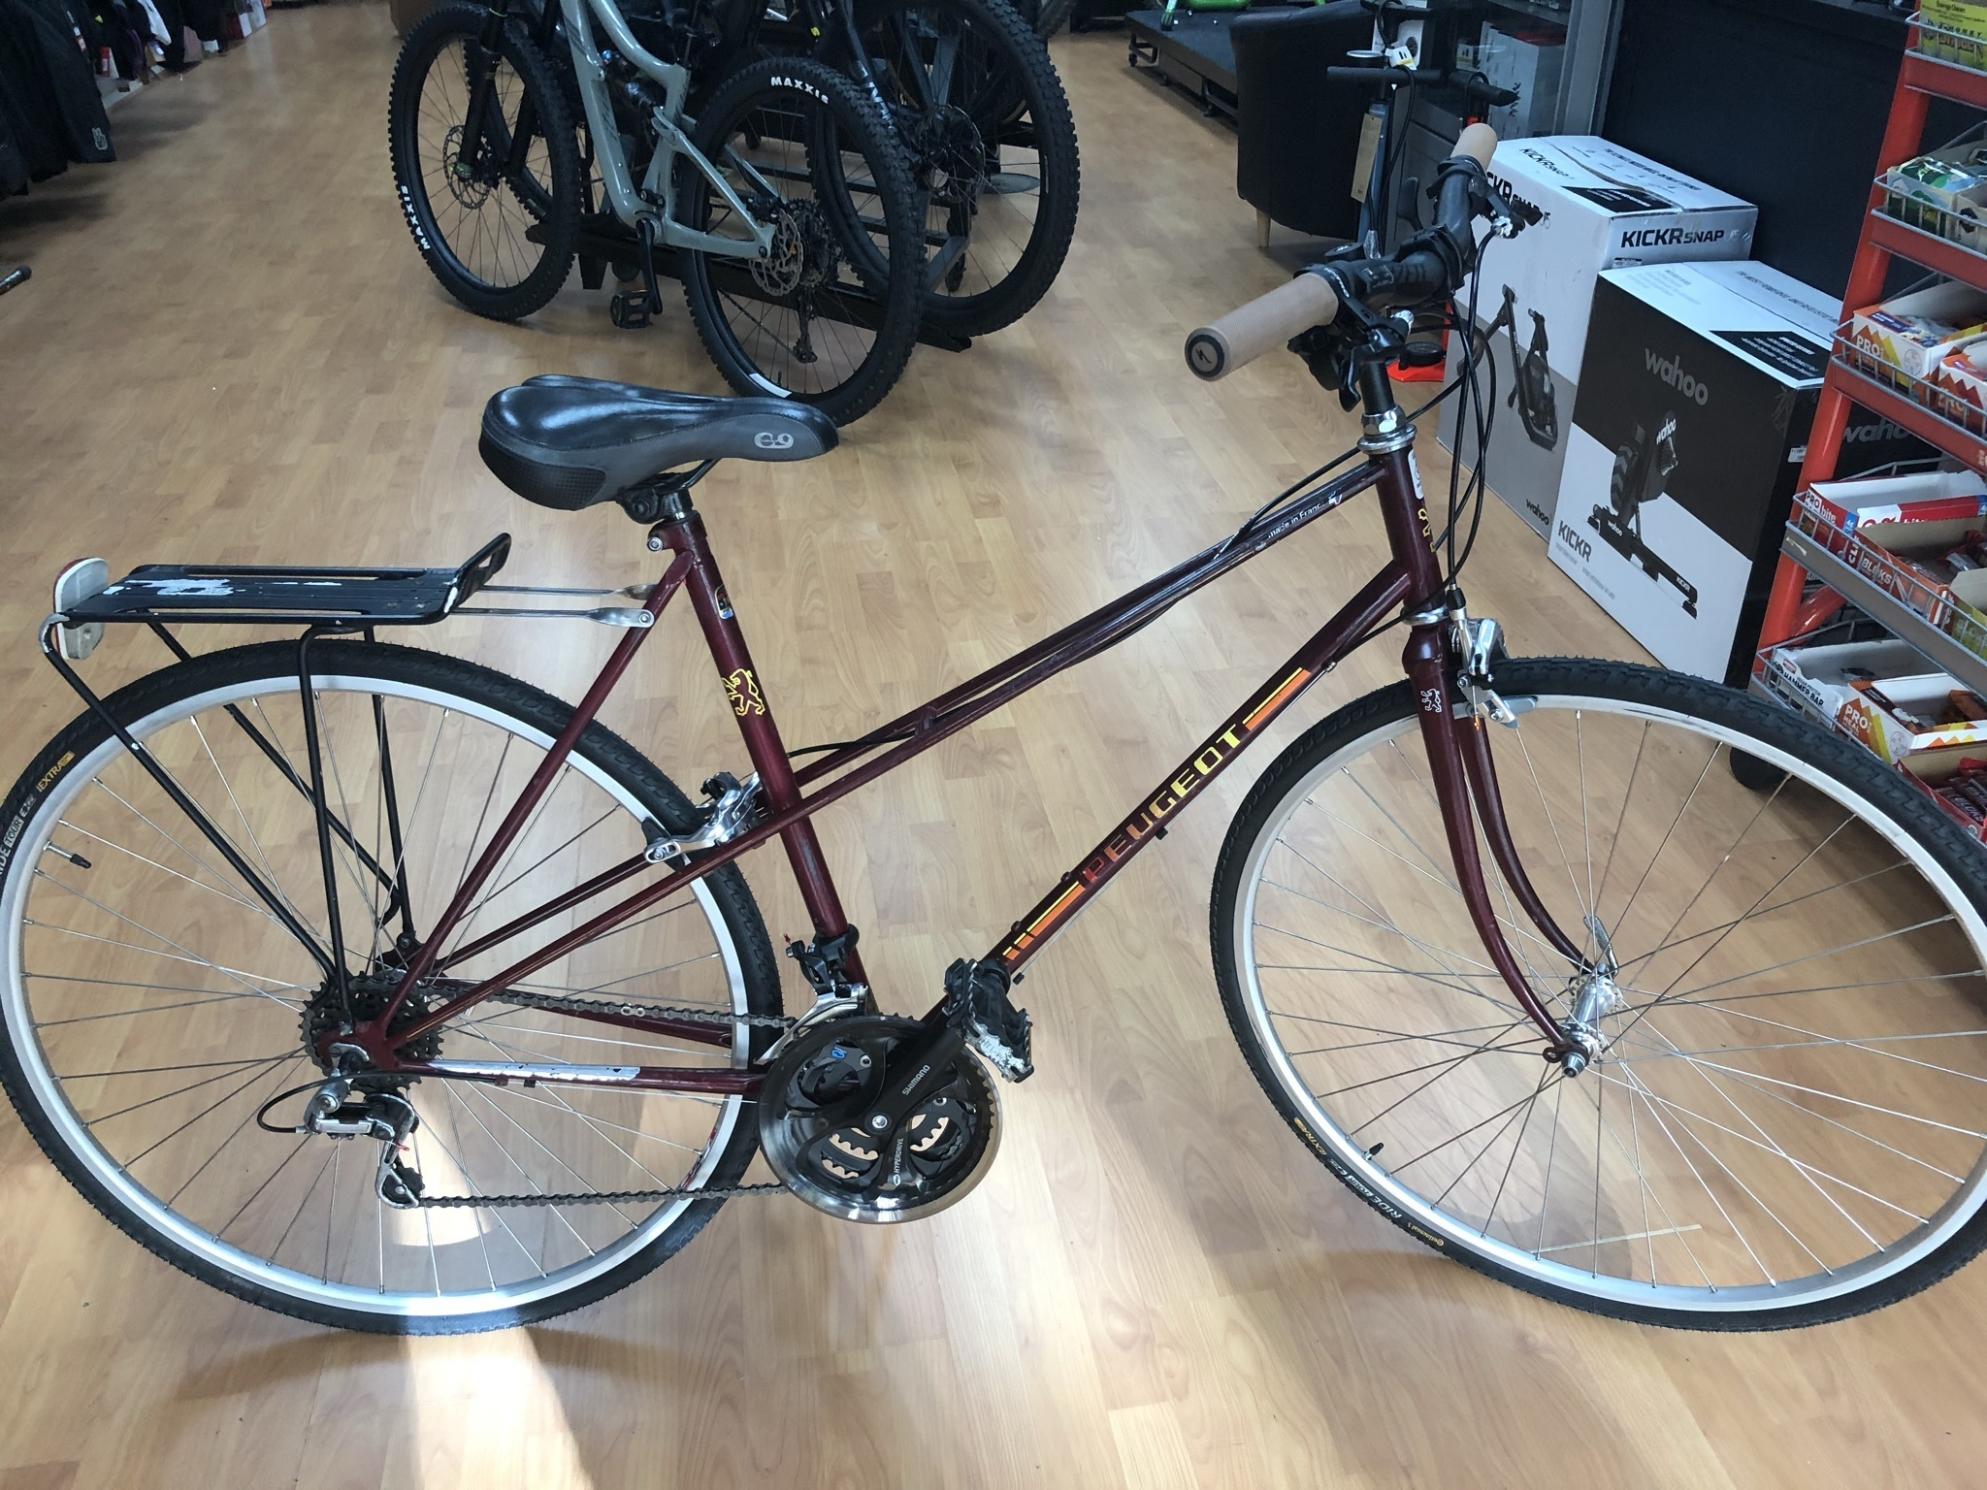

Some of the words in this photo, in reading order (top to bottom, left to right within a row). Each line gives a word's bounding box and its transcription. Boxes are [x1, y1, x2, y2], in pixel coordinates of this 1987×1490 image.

[770, 75, 829, 105] MAXXIS
[400, 185, 431, 251] MAXXIS
[1620, 227, 1685, 249] KICKR
[1683, 229, 1725, 244] SNAP
[1644, 348, 1709, 406] wahoo
[1656, 418, 1677, 445] wahoo
[1526, 498, 1550, 526] wahoo
[1558, 519, 1593, 563] KICKR
[1845, 704, 1869, 728] PRO
[1082, 723, 1241, 883] PEUGEOT
[902, 1063, 931, 1096] SHIMANO
[1374, 1196, 1403, 1220] RIDE
